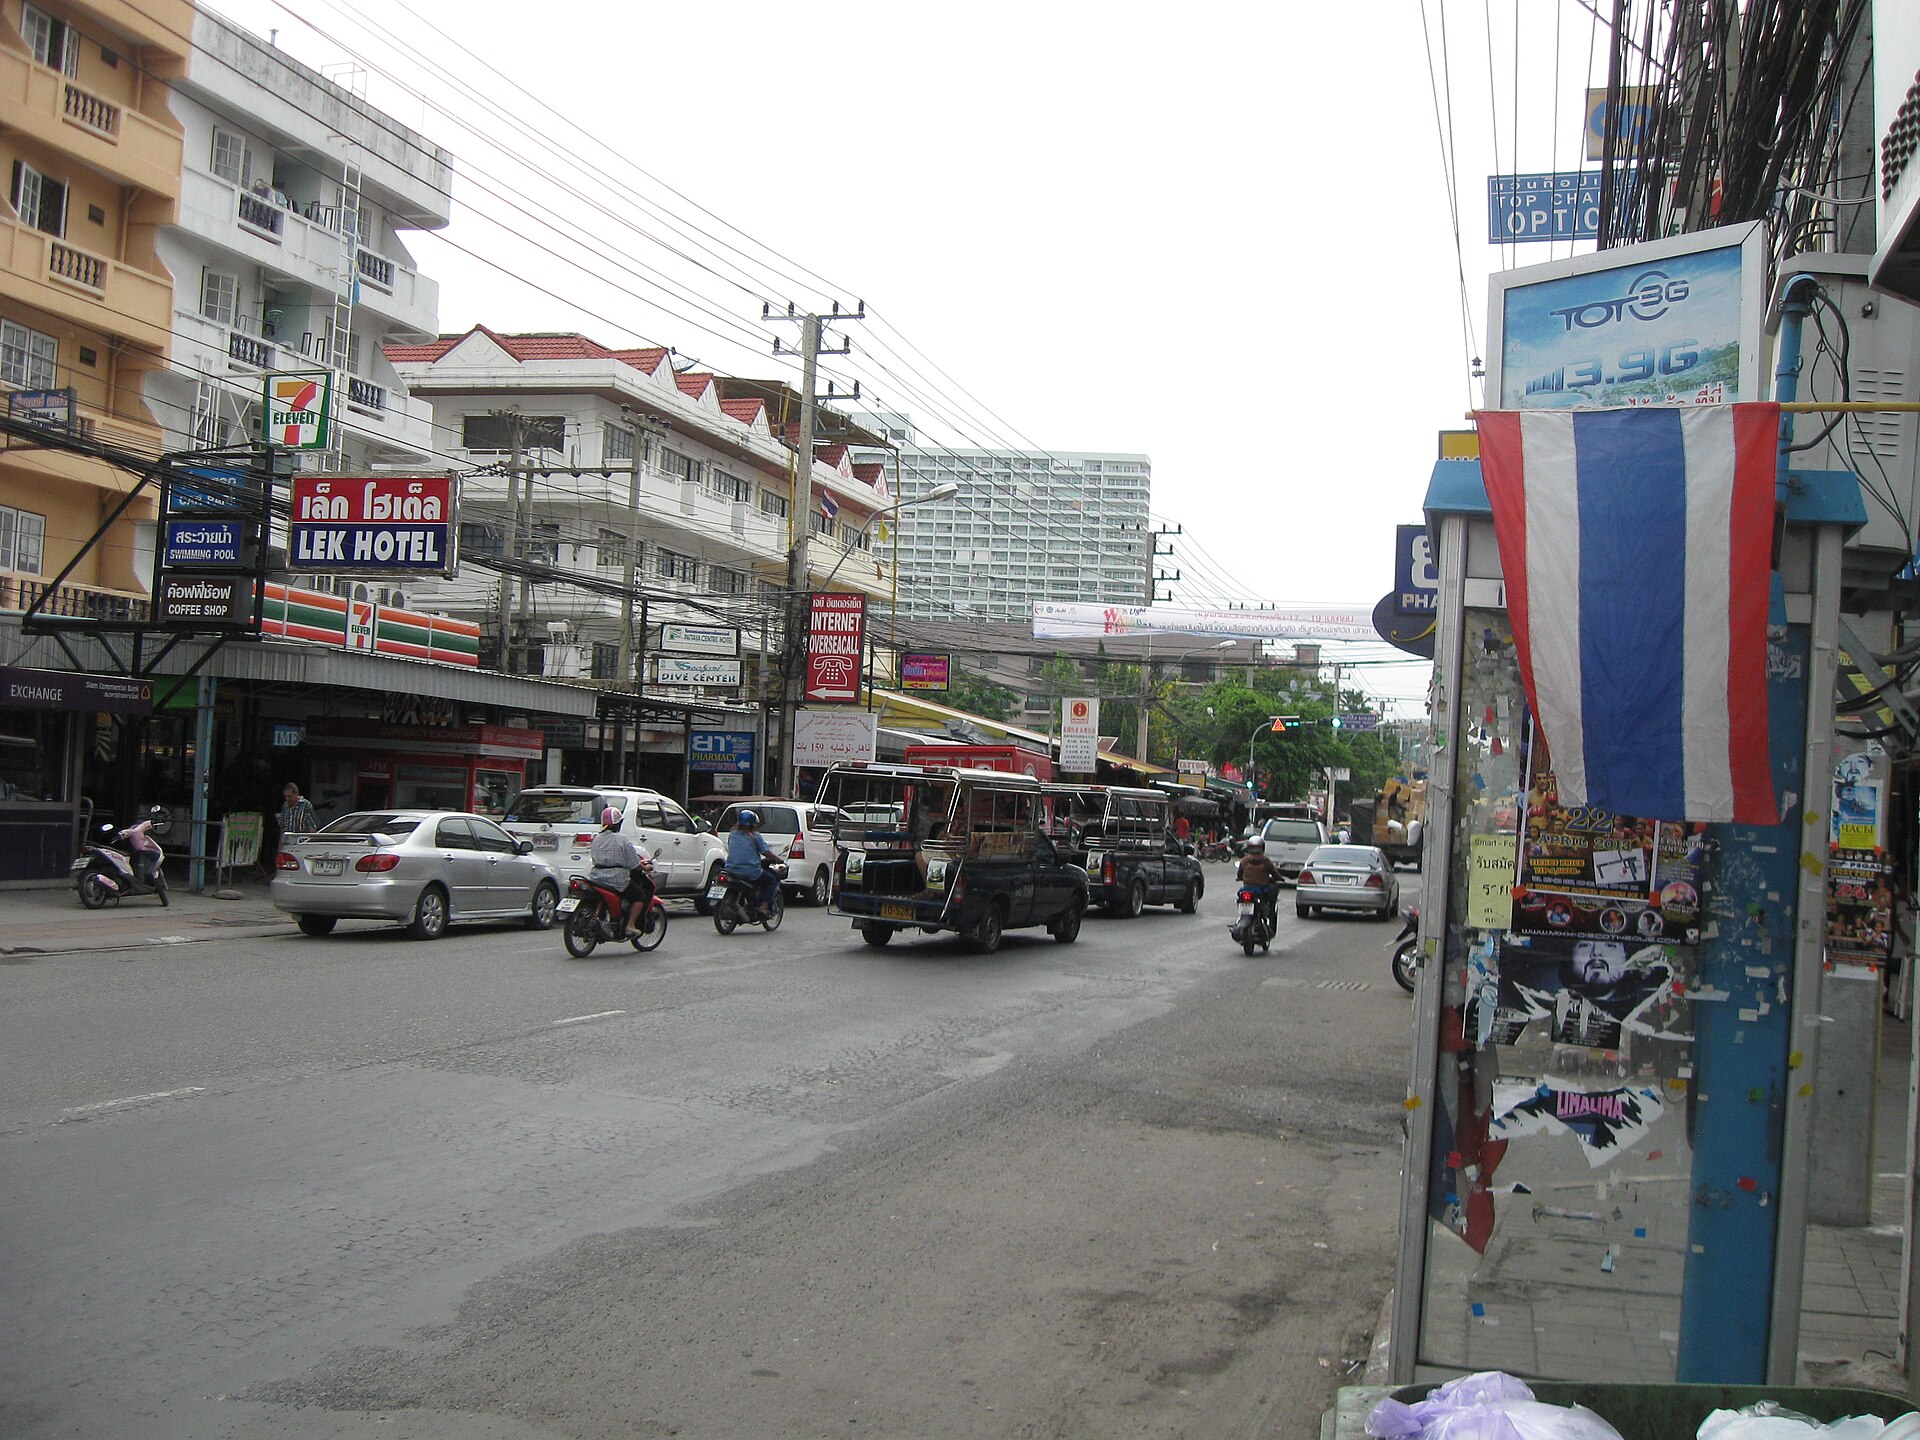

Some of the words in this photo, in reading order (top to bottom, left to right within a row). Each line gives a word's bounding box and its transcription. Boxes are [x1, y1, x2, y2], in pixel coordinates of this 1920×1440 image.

[1495, 194, 1537, 209] TOP
[1552, 191, 1600, 206] CHA
[1550, 295, 1639, 331] TOT
[1566, 338, 1699, 389] 3.9G
[301, 482, 349, 520] เล็ก
[363, 481, 442, 520] โฮเต็ล
[175, 525, 232, 545] สระว่ายน้ำ
[298, 530, 347, 560] LEK
[353, 530, 439, 562] HOTEL
[169, 549, 212, 560] SWIMMING
[213, 549, 236, 561] POOL
[168, 604, 202, 615] COFFEE
[203, 605, 228, 616] SHOP
[810, 611, 862, 632] INTERNET
[809, 634, 859, 655] OVERSEACALL
[661, 673, 689, 681] DIVE
[692, 673, 736, 683] CENTER
[10, 684, 63, 701] EXCHANGE
[99, 682, 127, 691] Commercial
[127, 684, 140, 692] Bank
[380, 726, 427, 738] CURRENCY
[429, 729, 479, 741] EXCHANGE
[811, 742, 825, 752] 159
[692, 752, 737, 762] PHARMACY
[1179, 761, 1206, 769] TATTOO
[1564, 806, 1616, 834] 22
[1841, 824, 1873, 834] ЧАСЫ
[1474, 838, 1497, 848] Smart
[1538, 833, 1589, 848] APRIL
[1593, 836, 1633, 852] 2013
[1835, 884, 1866, 900] 24
